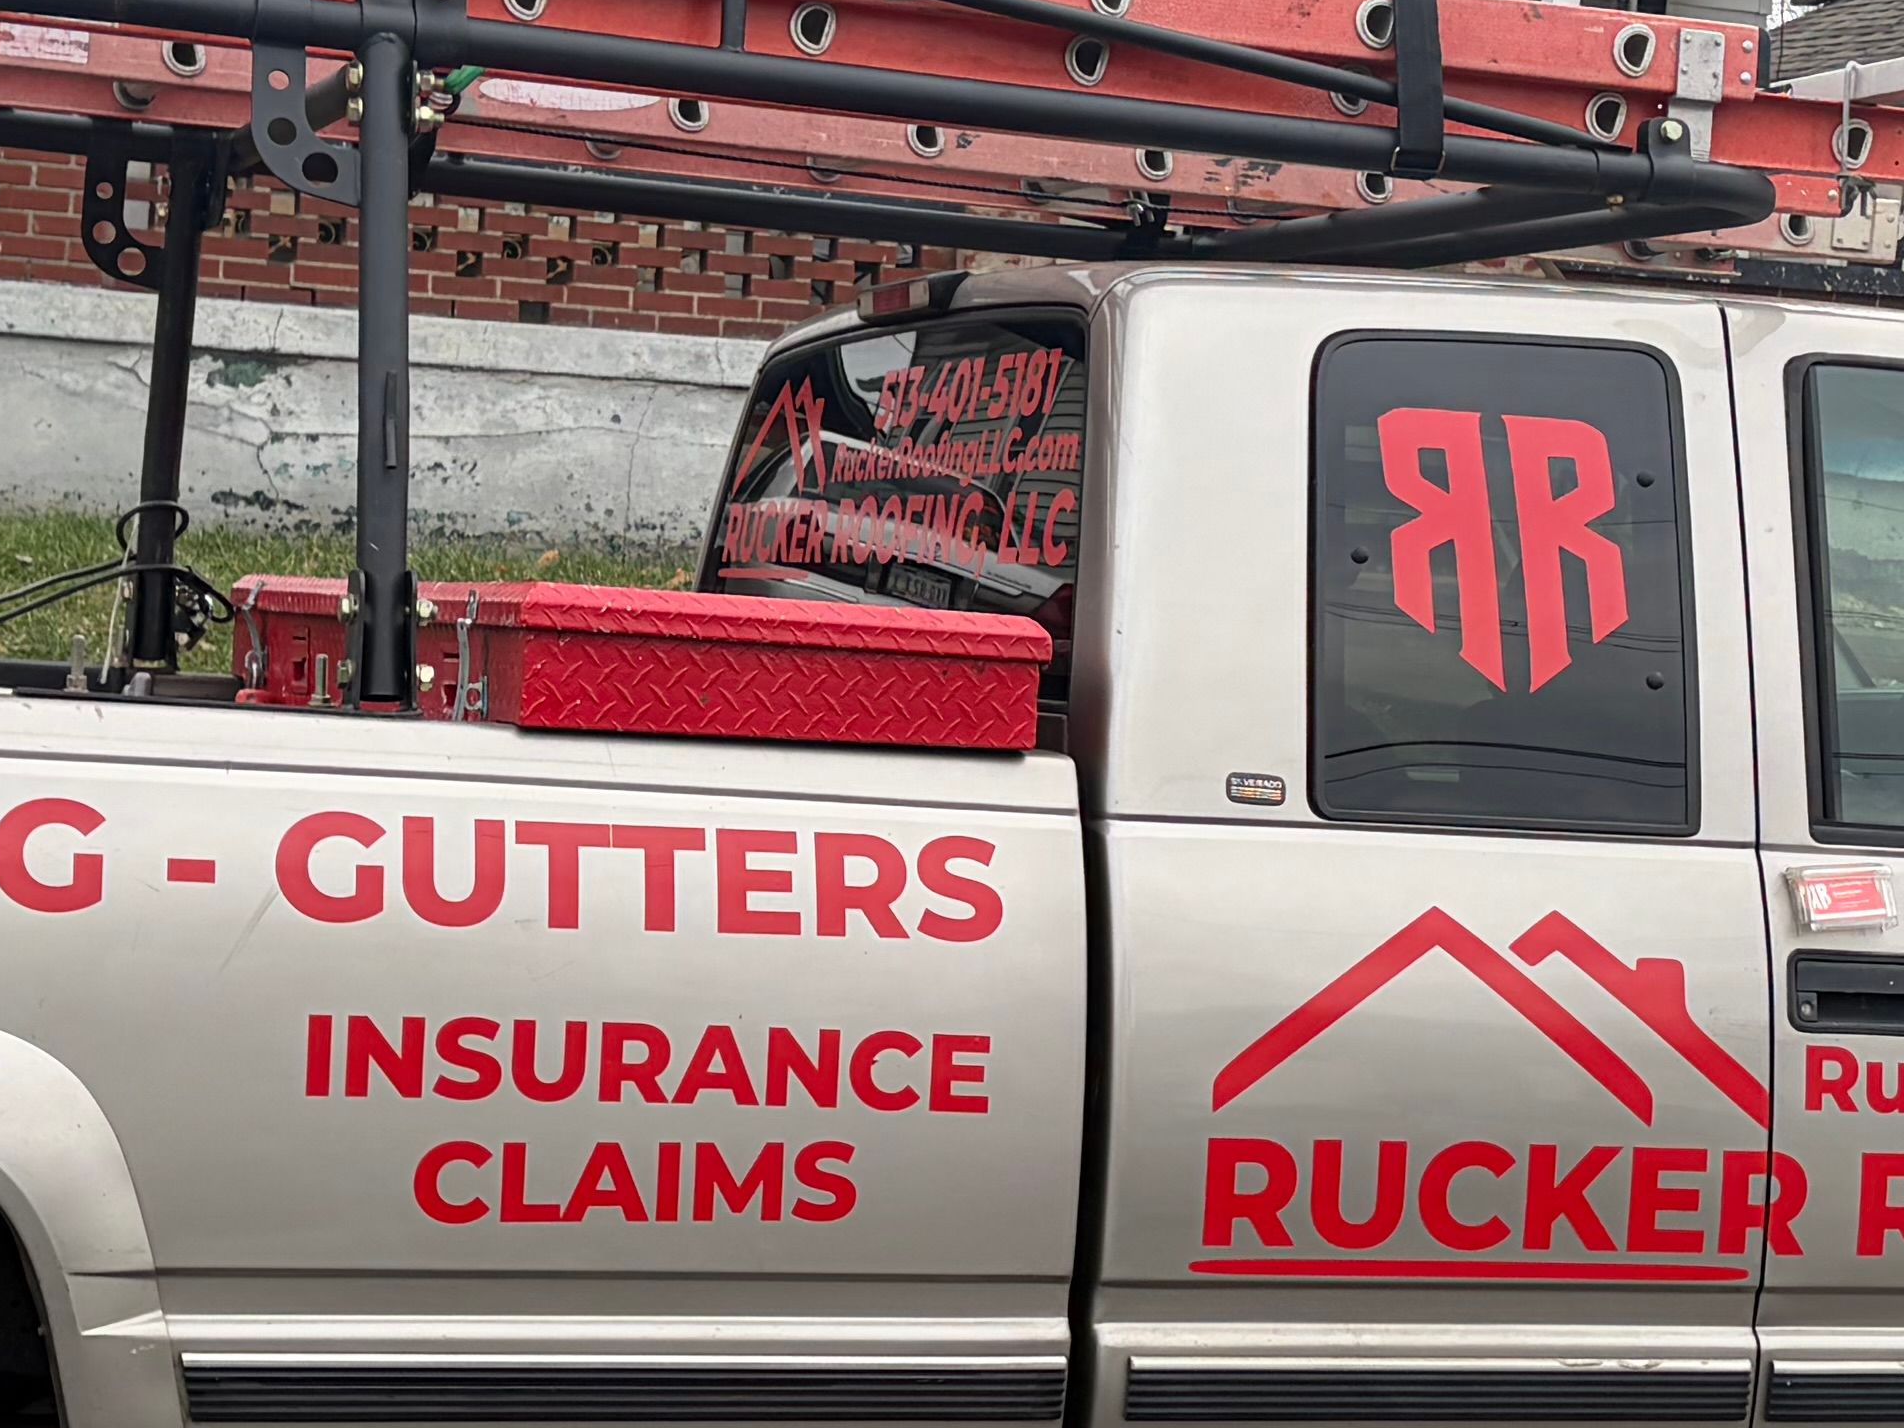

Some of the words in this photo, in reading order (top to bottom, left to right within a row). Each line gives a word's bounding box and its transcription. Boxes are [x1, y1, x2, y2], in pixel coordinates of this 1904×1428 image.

[874, 347, 1063, 430] 513-401-5181
[831, 427, 1080, 487] RuckerRoofingLLC.com
[721, 500, 831, 564] RUCKER
[831, 492, 988, 578] ROOFING,
[997, 488, 1077, 567] LLC
[276, 811, 1004, 943] GUTTERS
[305, 1014, 992, 1115] INSURANCE
[413, 1140, 859, 1226] CLAIMS
[1202, 1137, 1809, 1258] RUCKER
